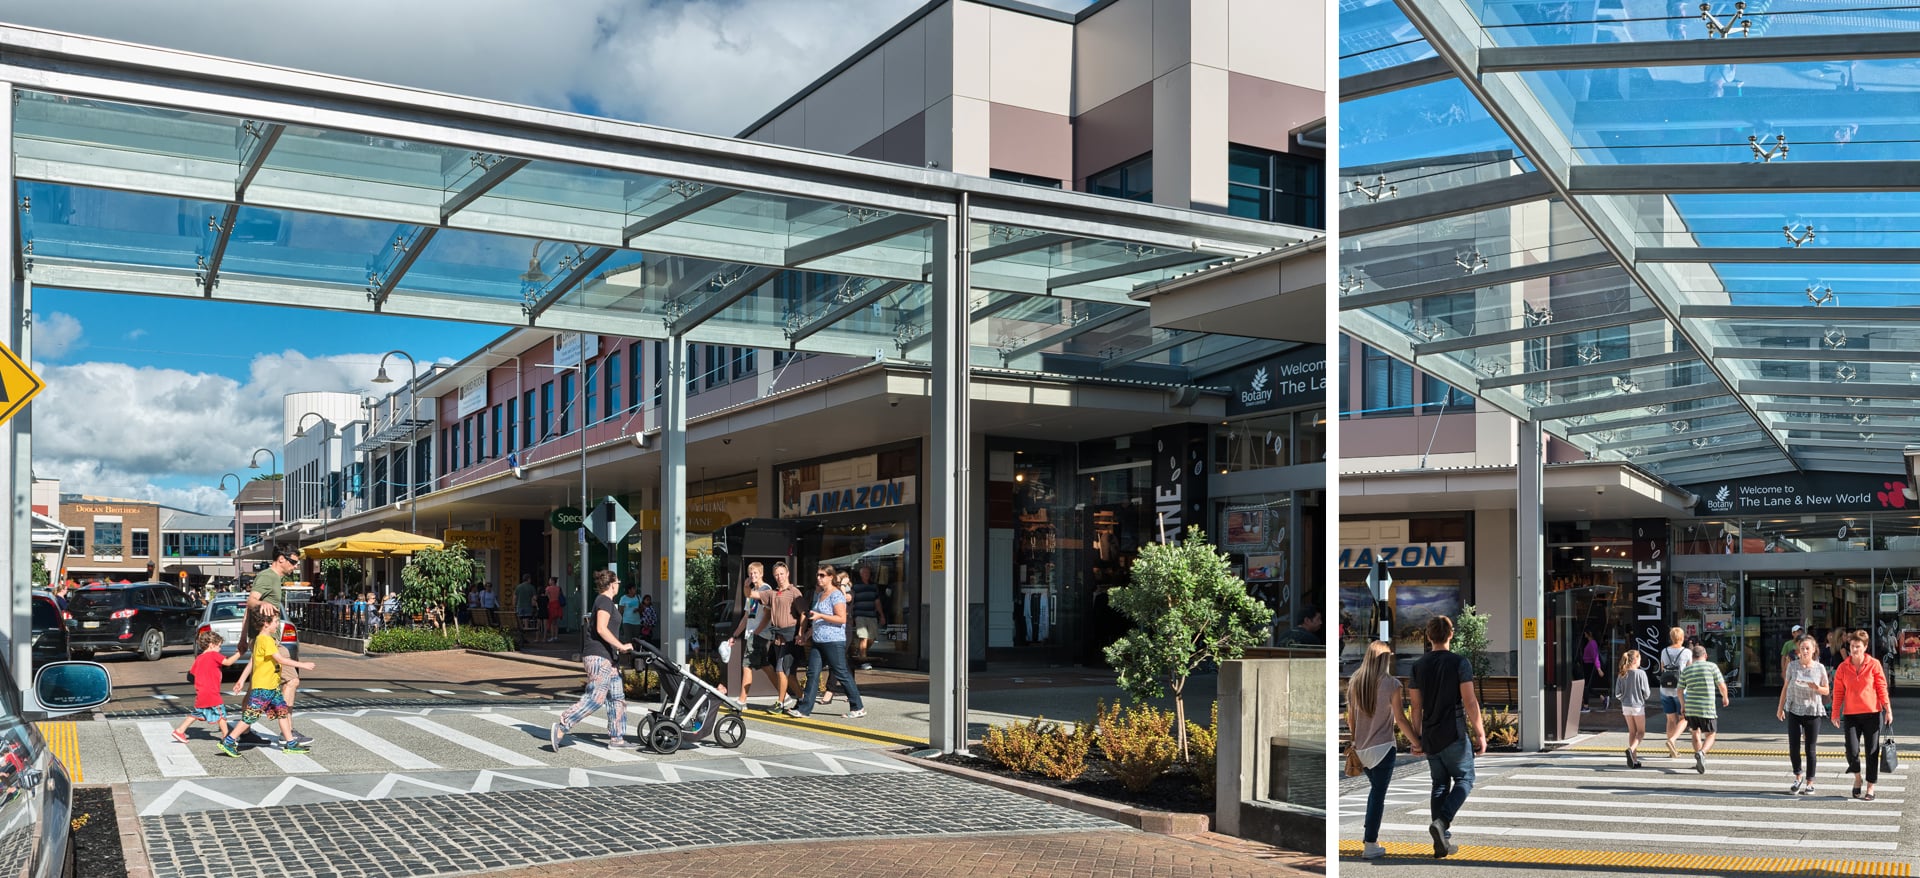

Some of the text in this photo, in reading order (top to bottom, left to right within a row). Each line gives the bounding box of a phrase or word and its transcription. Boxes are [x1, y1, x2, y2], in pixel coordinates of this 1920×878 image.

[1280, 380, 1306, 395] The
[1241, 389, 1273, 403] Botany
[1739, 484, 1795, 495] Welcome to
[806, 481, 904, 515] AMAZON
[1707, 499, 1734, 509] Botany
[1739, 492, 1871, 507] The Lane & New World
[1156, 484, 1181, 547] ANE
[1636, 561, 1661, 674] The LANE
